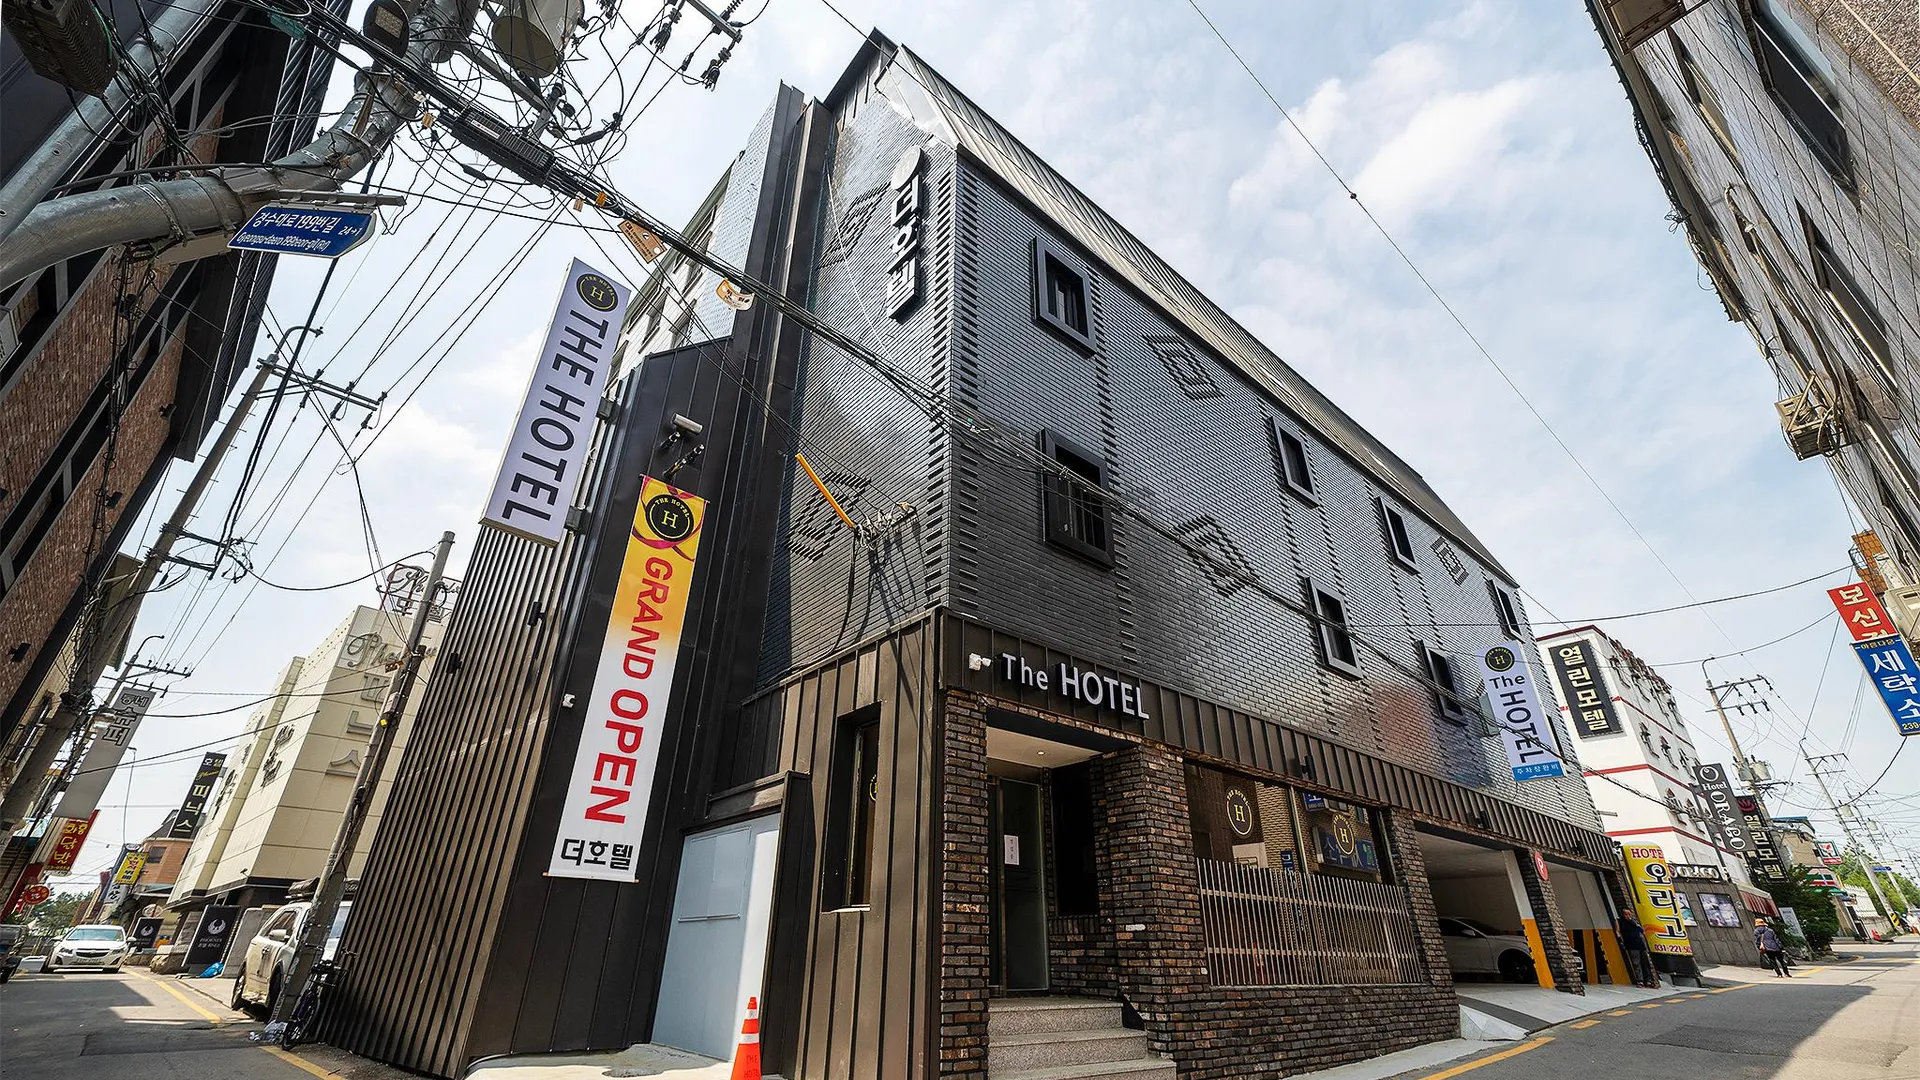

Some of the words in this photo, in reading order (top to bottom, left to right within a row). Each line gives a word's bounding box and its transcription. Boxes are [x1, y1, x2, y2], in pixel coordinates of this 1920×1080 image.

[552, 309, 609, 387] THE
[501, 384, 586, 522] HOTEL
[661, 510, 678, 529] H
[671, 498, 690, 519] HOTEL
[623, 556, 673, 680] GRAND
[1002, 653, 1048, 690] The
[1060, 662, 1150, 720] HOTEL
[1489, 674, 1526, 690] The
[1559, 645, 1609, 732] 열린모텔
[584, 688, 649, 824] OPEN
[1500, 689, 1544, 764] HOTEL
[174, 784, 211, 832] 피닉스
[1702, 781, 1728, 791] Hotel
[560, 838, 633, 871] 더호텔
[1744, 814, 1784, 879] 열린모텔
[1642, 862, 1688, 940] 오라고
